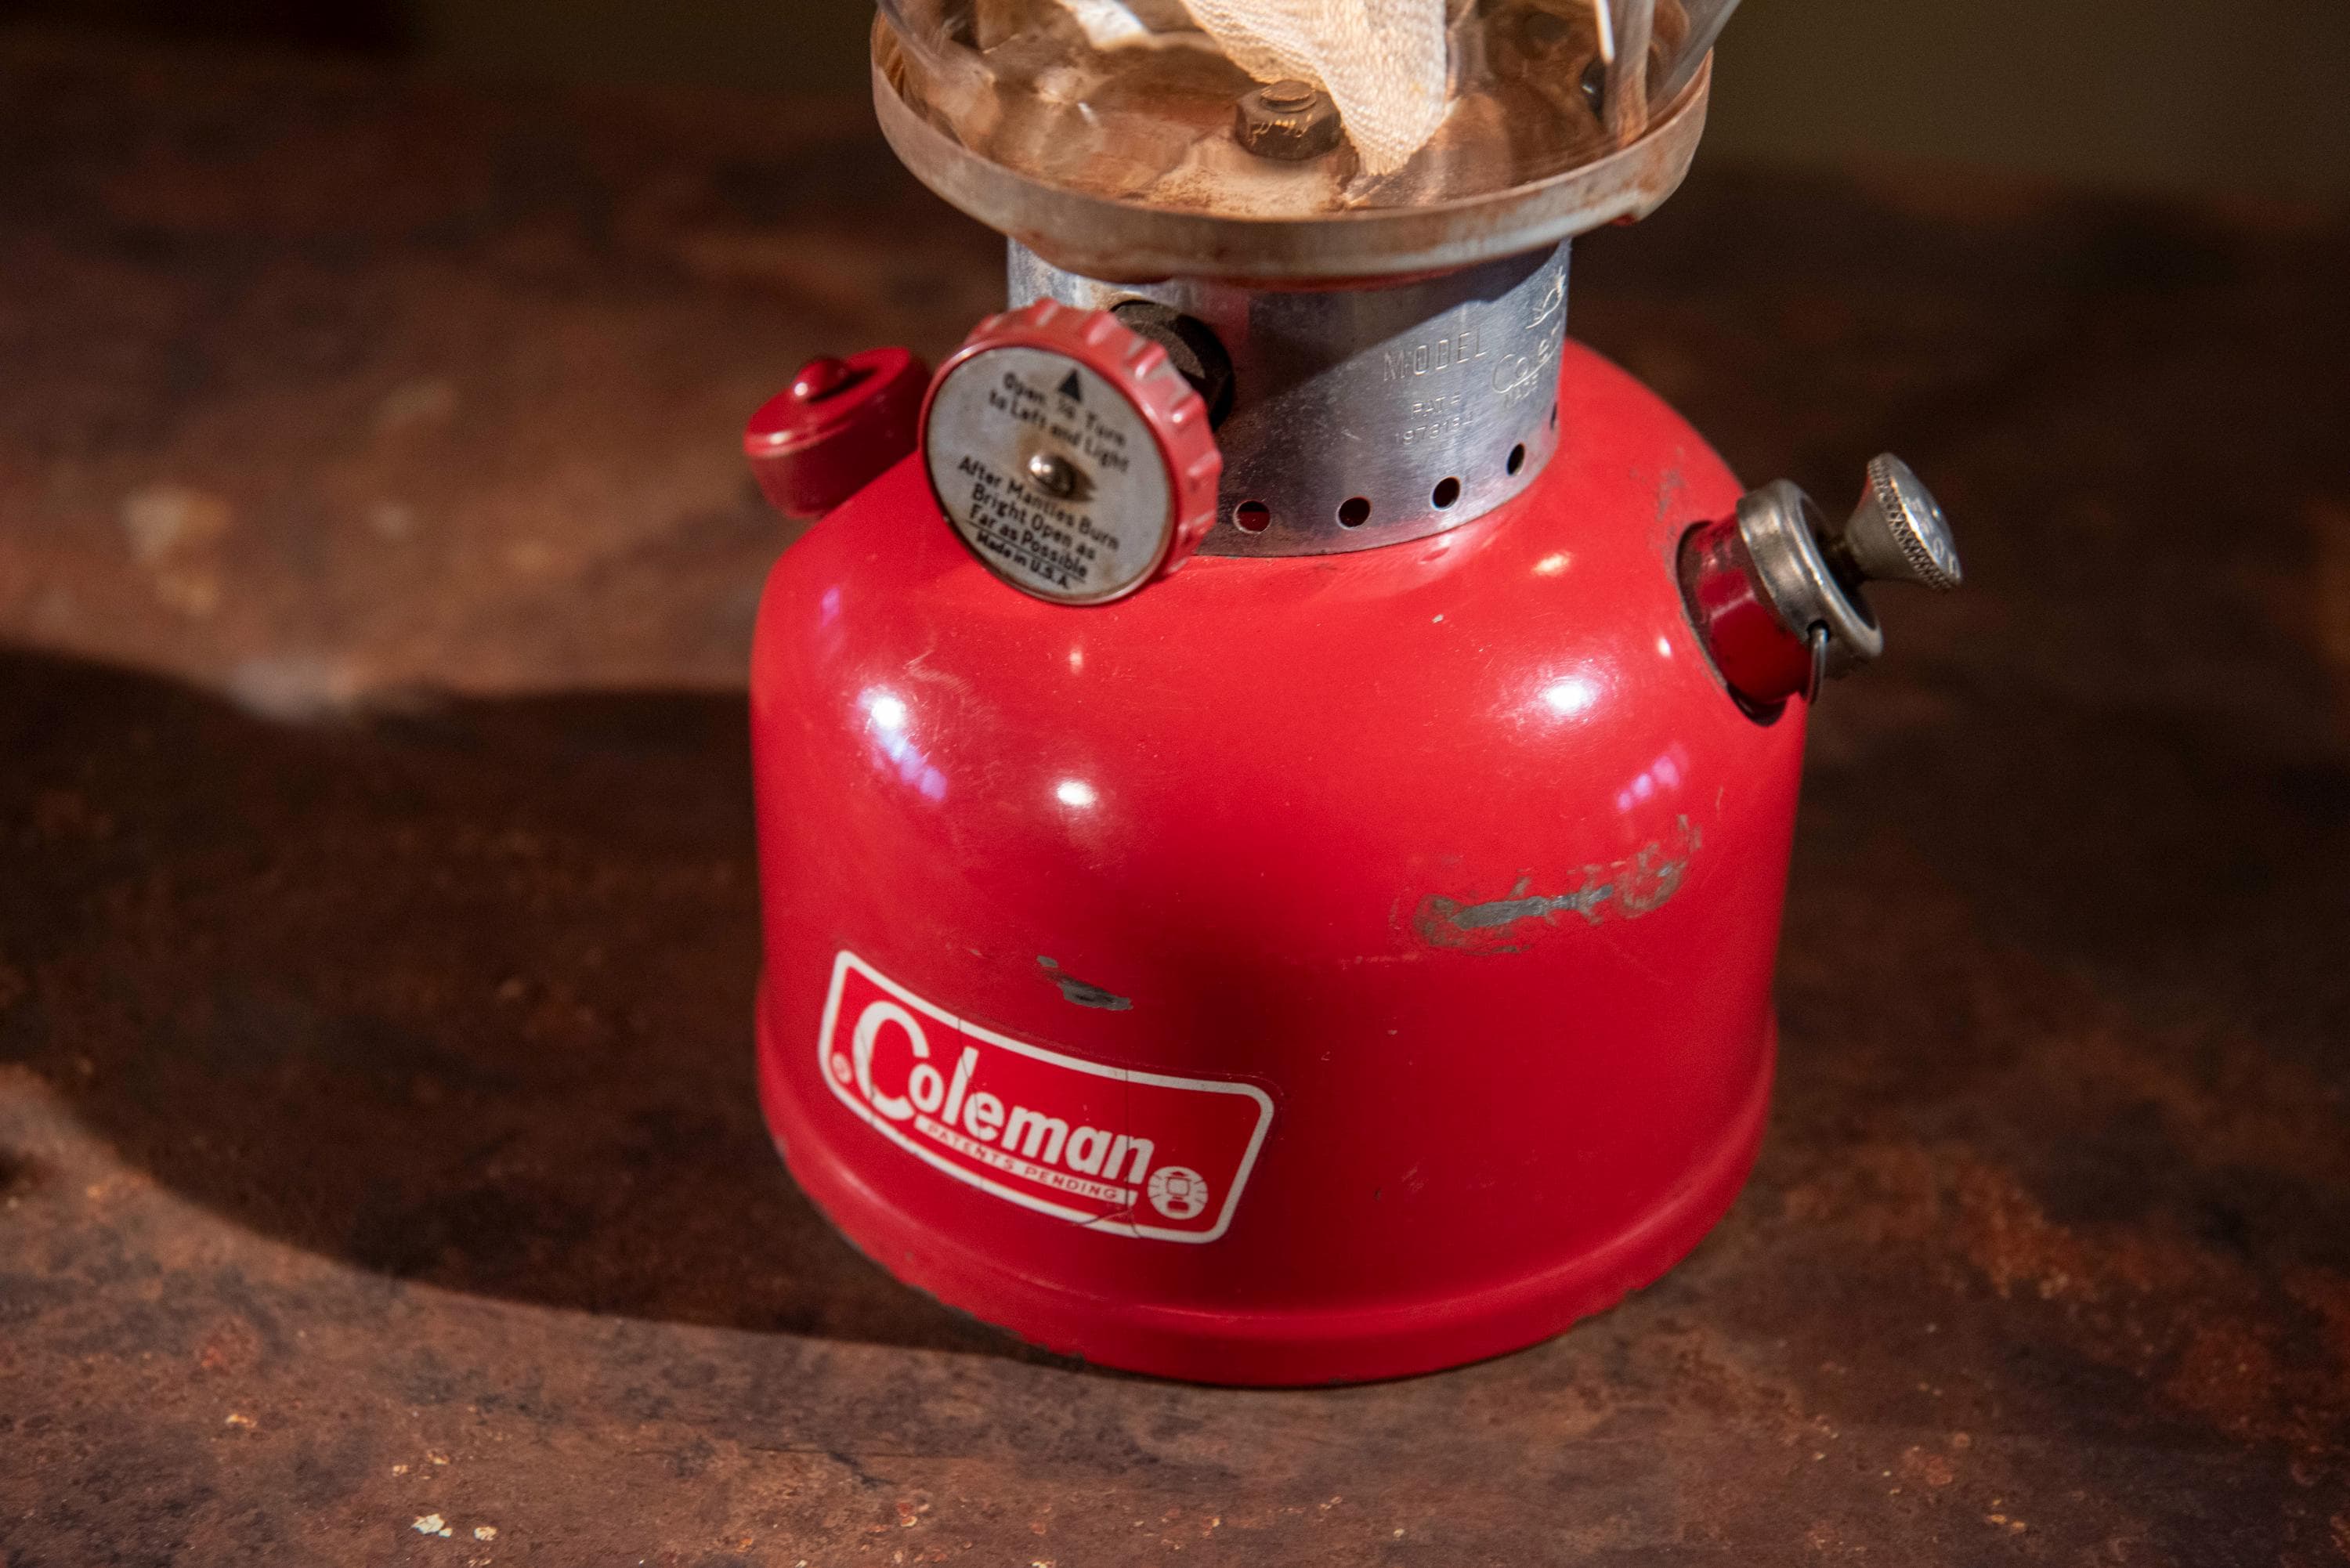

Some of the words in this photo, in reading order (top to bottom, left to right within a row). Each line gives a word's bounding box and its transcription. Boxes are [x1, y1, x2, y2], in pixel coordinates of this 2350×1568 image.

[1383, 327, 1487, 381] MODEL
[1010, 398, 1047, 431] Left
[958, 455, 1002, 488] After
[1007, 478, 1075, 528] Mantles
[1079, 516, 1120, 550] Burn
[971, 482, 1028, 524] Bright
[1032, 514, 1073, 547] Open
[1076, 544, 1096, 560] as
[970, 504, 996, 529] Far
[1000, 525, 1018, 541] as
[1021, 529, 1087, 578] Possible
[977, 530, 1011, 558] Made
[1013, 552, 1028, 567] in
[852, 1000, 1154, 1184] Coleman
[928, 1124, 1015, 1170] PATENTS
[1024, 1165, 1119, 1200] PENDING
